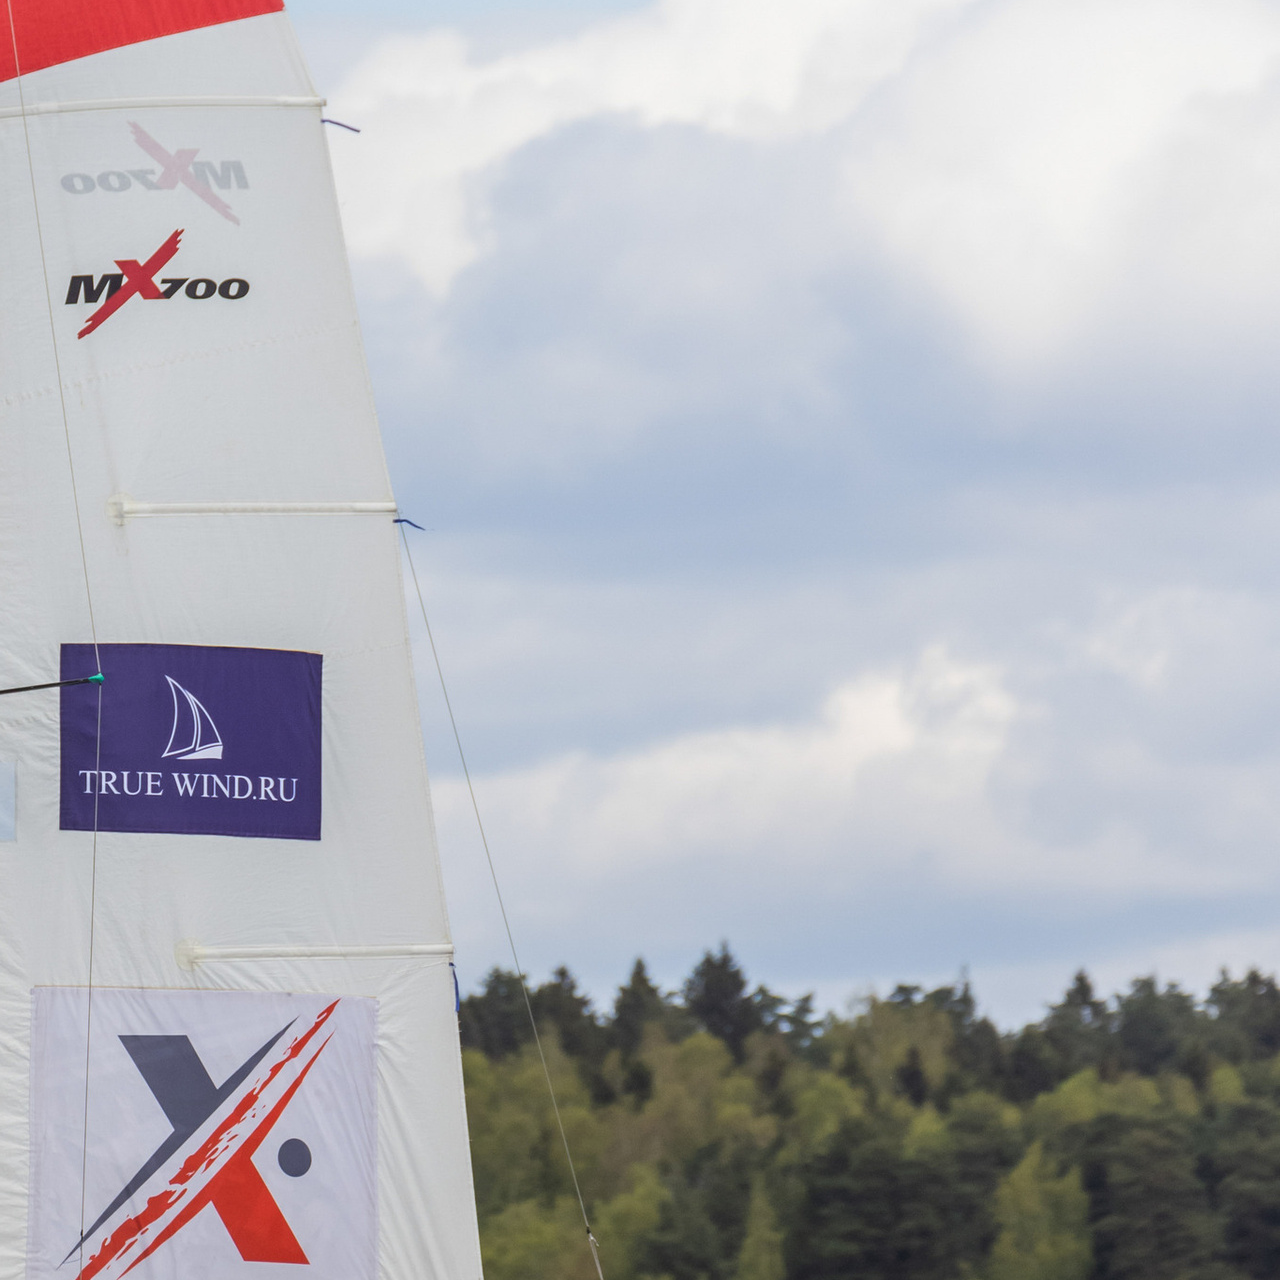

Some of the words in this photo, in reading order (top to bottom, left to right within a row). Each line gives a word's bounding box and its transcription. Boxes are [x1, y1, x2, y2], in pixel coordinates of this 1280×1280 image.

[65, 228, 250, 340] MX700
[79, 770, 164, 796] TRUE
[171, 773, 299, 802] WIND.RU
